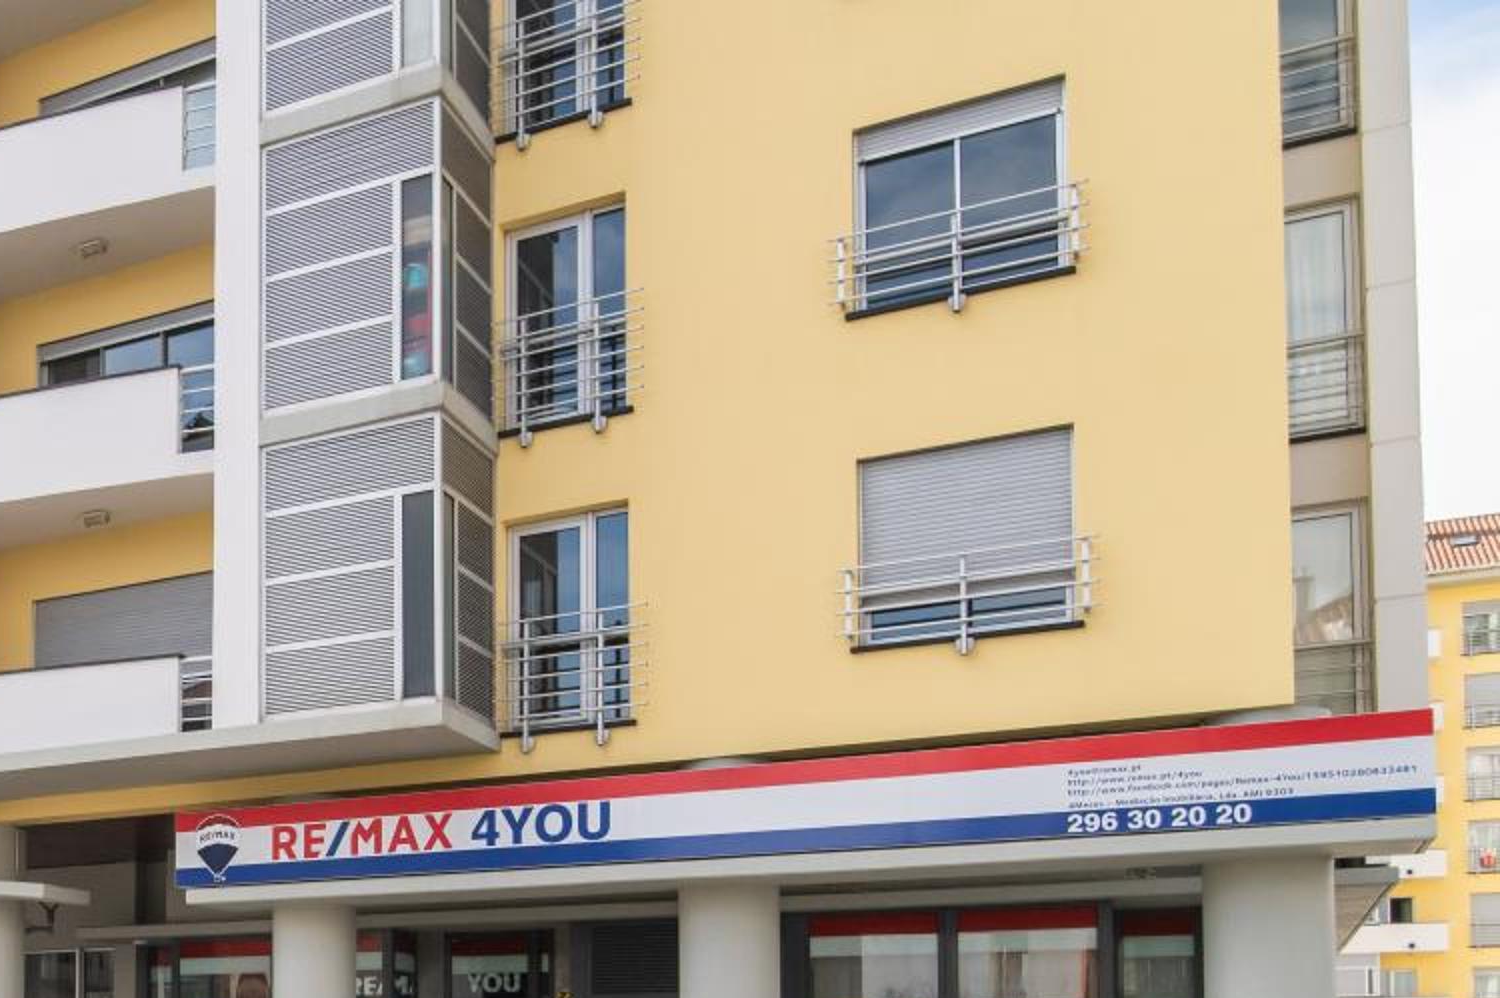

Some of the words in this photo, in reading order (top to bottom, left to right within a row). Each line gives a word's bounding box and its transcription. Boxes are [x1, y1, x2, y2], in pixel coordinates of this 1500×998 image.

[272, 813, 453, 861] RE/MAX
[471, 801, 611, 847] 4YOU
[1067, 811, 1118, 832] 296
[1127, 808, 1161, 829] 30
[1171, 806, 1206, 827] 20
[1216, 803, 1252, 824] 20
[199, 830, 236, 844] RE/MAX
